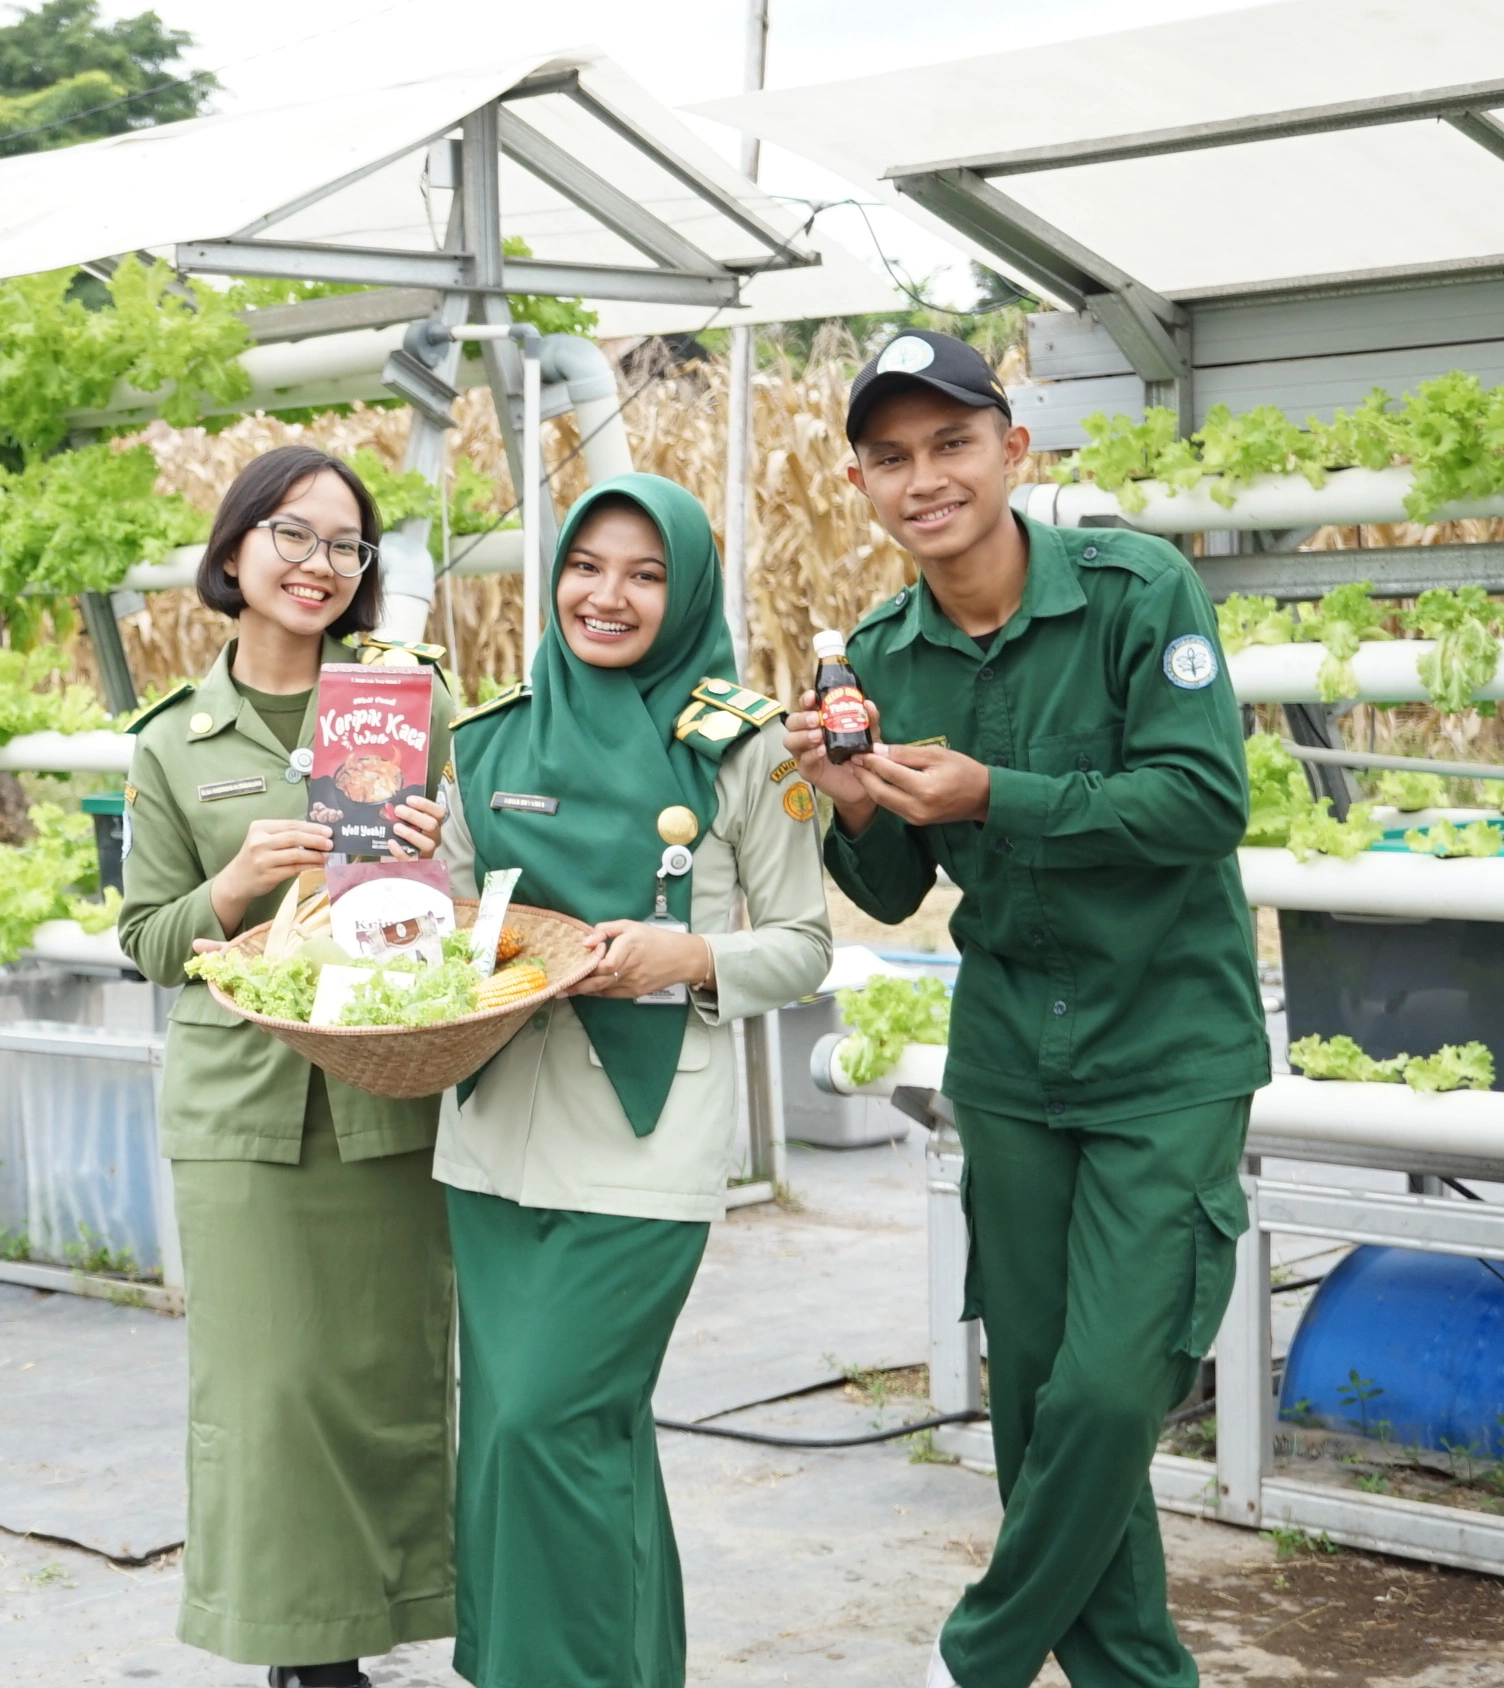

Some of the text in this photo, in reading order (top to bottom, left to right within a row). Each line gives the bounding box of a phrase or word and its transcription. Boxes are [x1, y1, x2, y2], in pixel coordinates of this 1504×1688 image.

[319, 708, 427, 752] Keripik Kaca
[341, 824, 359, 836] Well
